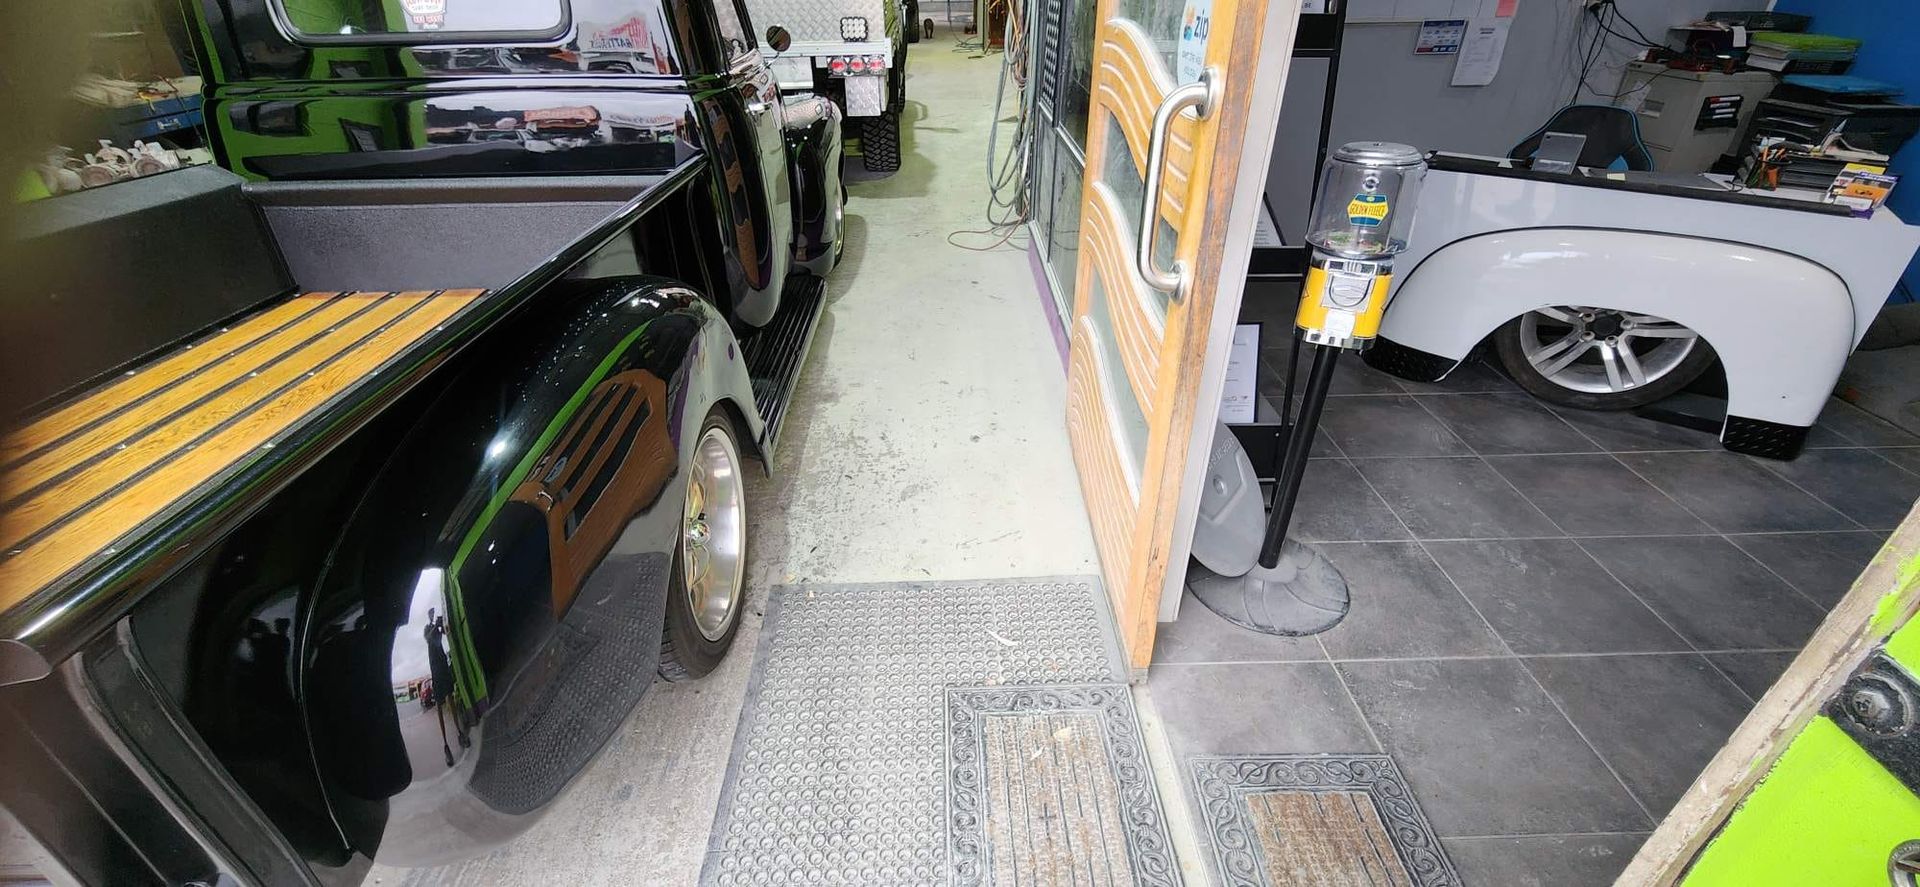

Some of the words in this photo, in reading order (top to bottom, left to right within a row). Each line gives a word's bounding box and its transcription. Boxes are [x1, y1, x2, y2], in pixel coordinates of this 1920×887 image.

[1194, 8, 1209, 45] zip
[1349, 203, 1367, 215] GOLDEN
[1367, 204, 1386, 217] FLEECE
